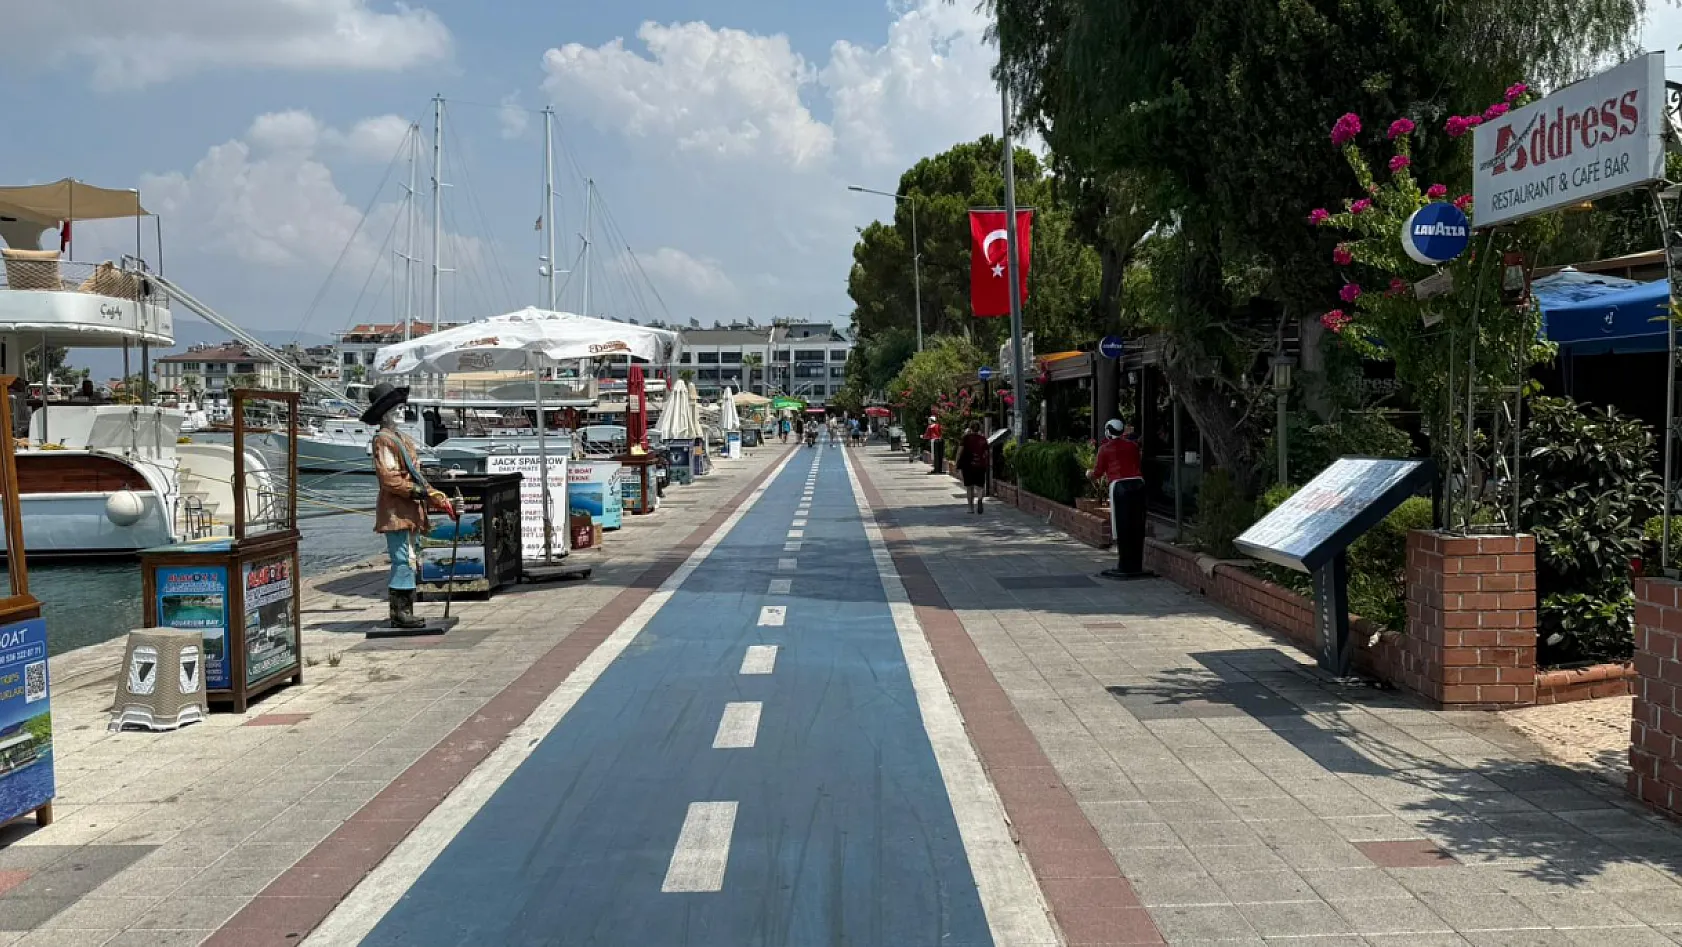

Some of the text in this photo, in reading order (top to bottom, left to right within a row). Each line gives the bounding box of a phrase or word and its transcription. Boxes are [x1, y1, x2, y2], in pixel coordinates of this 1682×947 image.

[1491, 176, 1556, 212] RESTAURANT
[1559, 172, 1569, 192] &
[1604, 152, 1630, 179] BAR
[1413, 221, 1466, 237] LAVAZZA
[492, 458, 563, 466] JACK SPAROW
[0, 628, 28, 648] OAT
